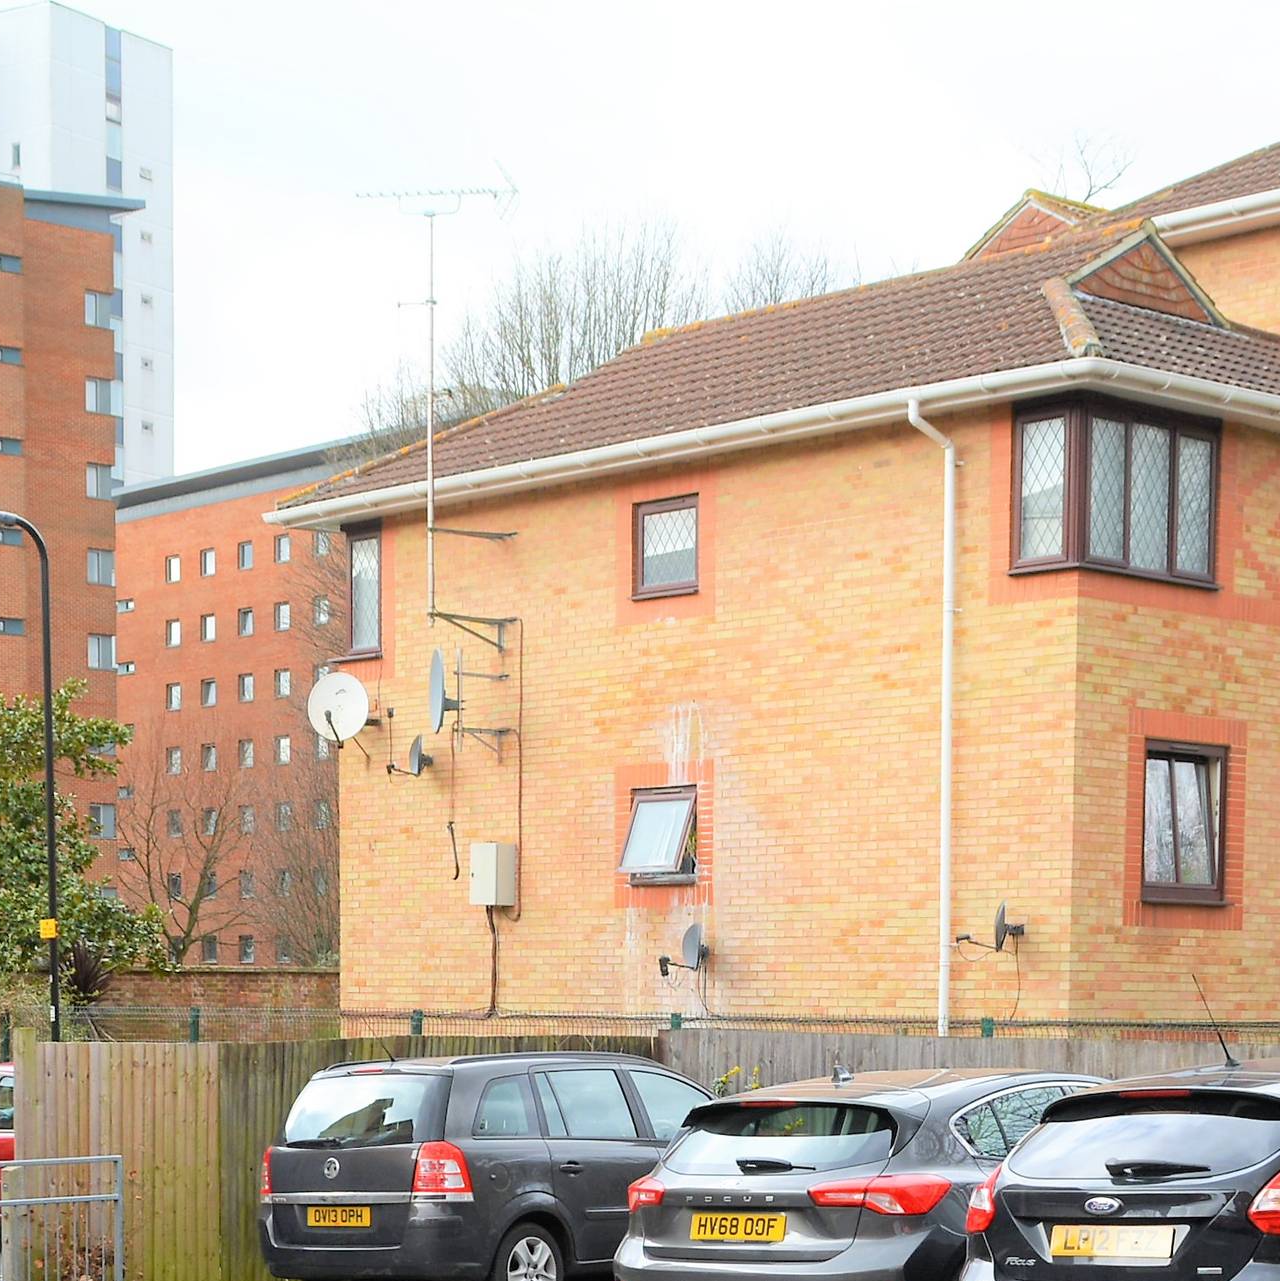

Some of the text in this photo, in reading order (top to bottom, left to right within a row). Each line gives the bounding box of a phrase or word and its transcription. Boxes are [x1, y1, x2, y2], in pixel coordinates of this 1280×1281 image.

[685, 1195, 774, 1203] FOCUS
[1087, 1199, 1116, 1212] Ford
[340, 1209, 363, 1223] OPH
[697, 1216, 739, 1236] HV68
